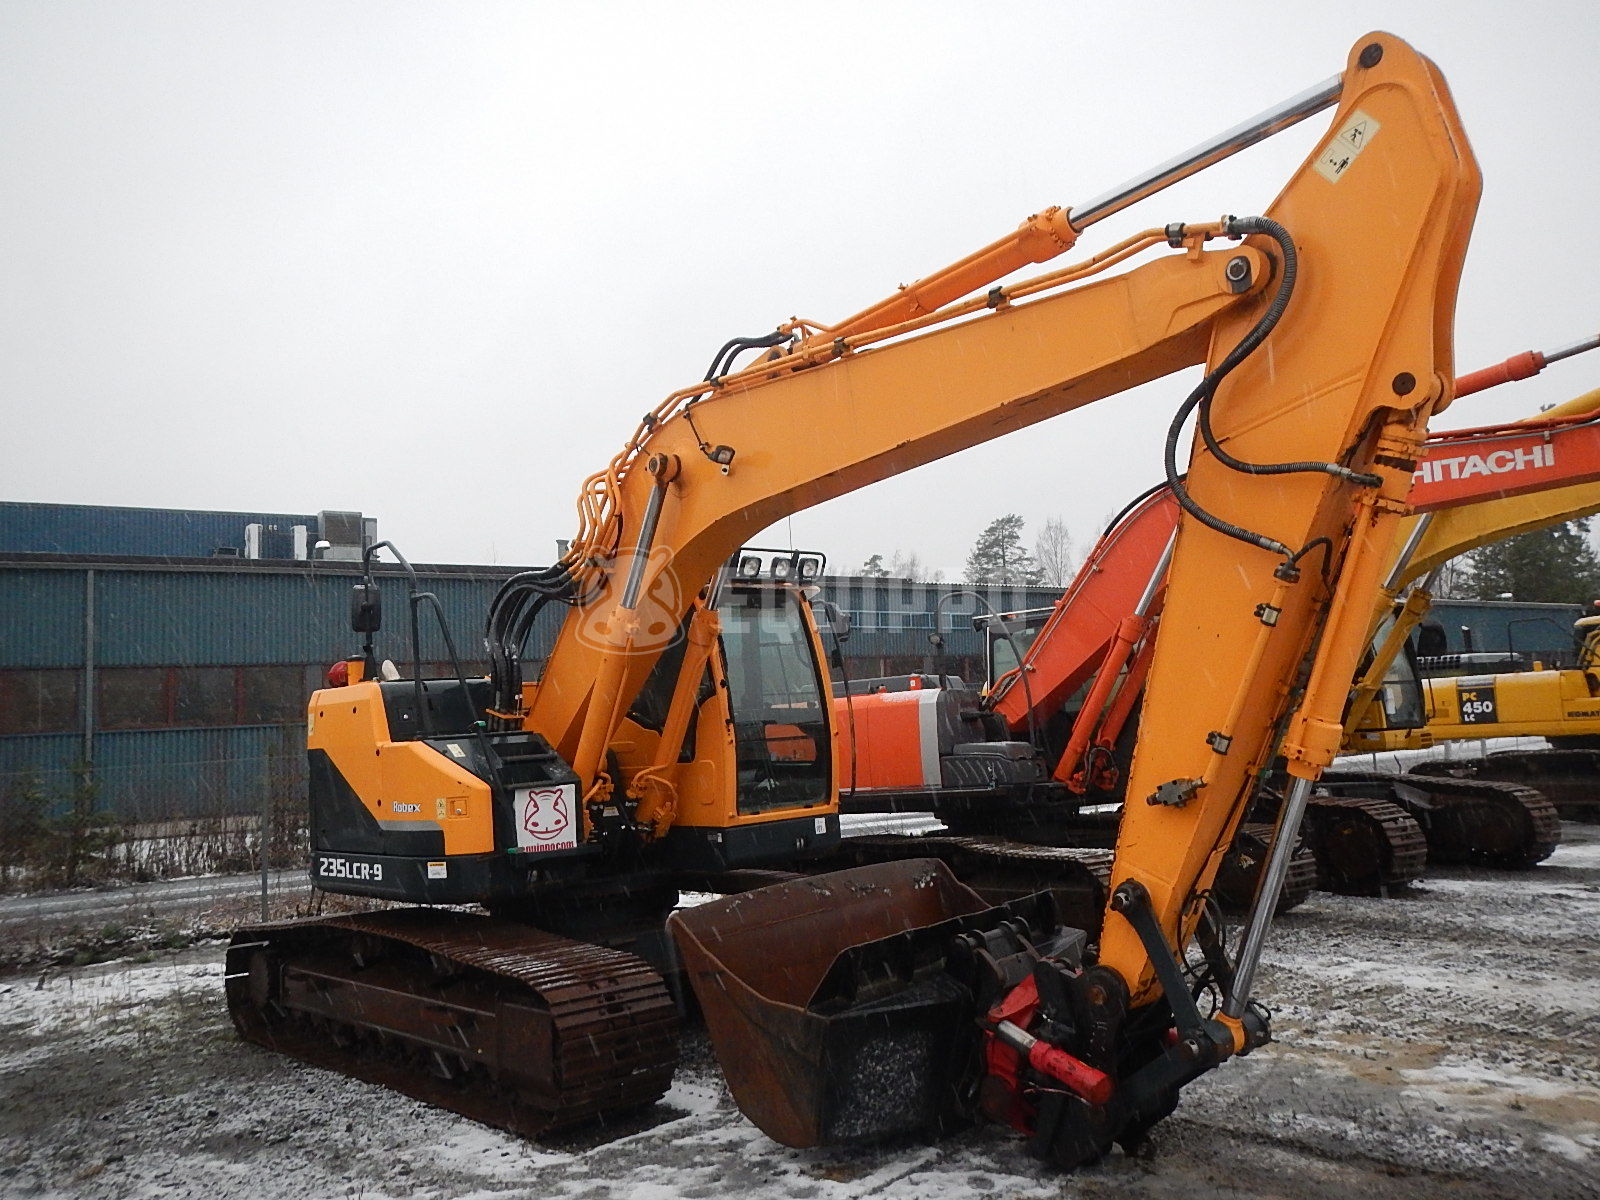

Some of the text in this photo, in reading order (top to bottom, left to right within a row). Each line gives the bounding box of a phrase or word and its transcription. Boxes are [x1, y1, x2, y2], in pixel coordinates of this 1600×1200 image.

[1412, 444, 1555, 484] HITACHI
[1461, 692, 1477, 701] PC
[1462, 701, 1493, 713] 450
[1464, 714, 1476, 722] LC
[393, 801, 422, 813] Robex
[319, 857, 383, 881] 235LCR-9
